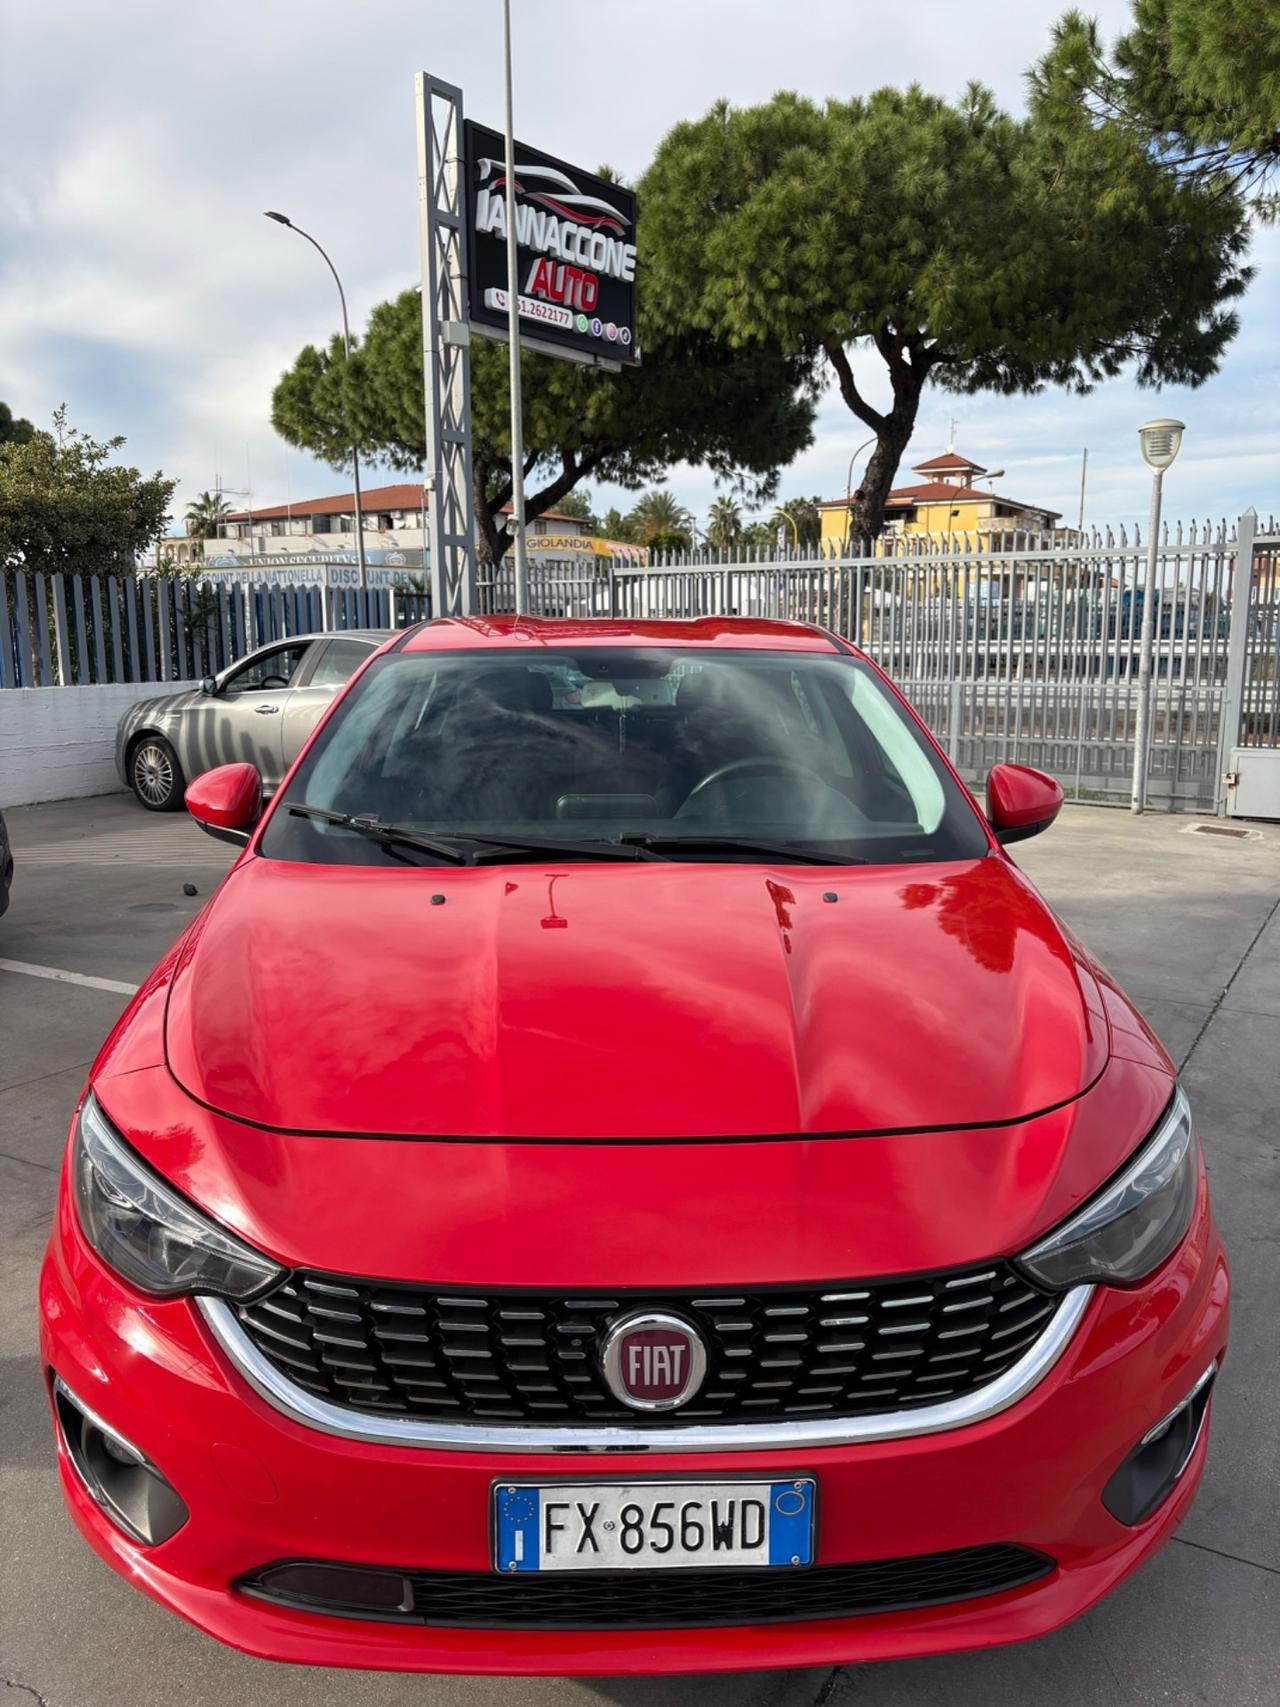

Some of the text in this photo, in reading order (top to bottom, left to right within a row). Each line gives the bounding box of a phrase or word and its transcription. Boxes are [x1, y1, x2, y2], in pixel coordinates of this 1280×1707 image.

[476, 188, 637, 283] IANNACCONE
[525, 257, 599, 312] AUTO
[628, 1344, 686, 1386] FIAT
